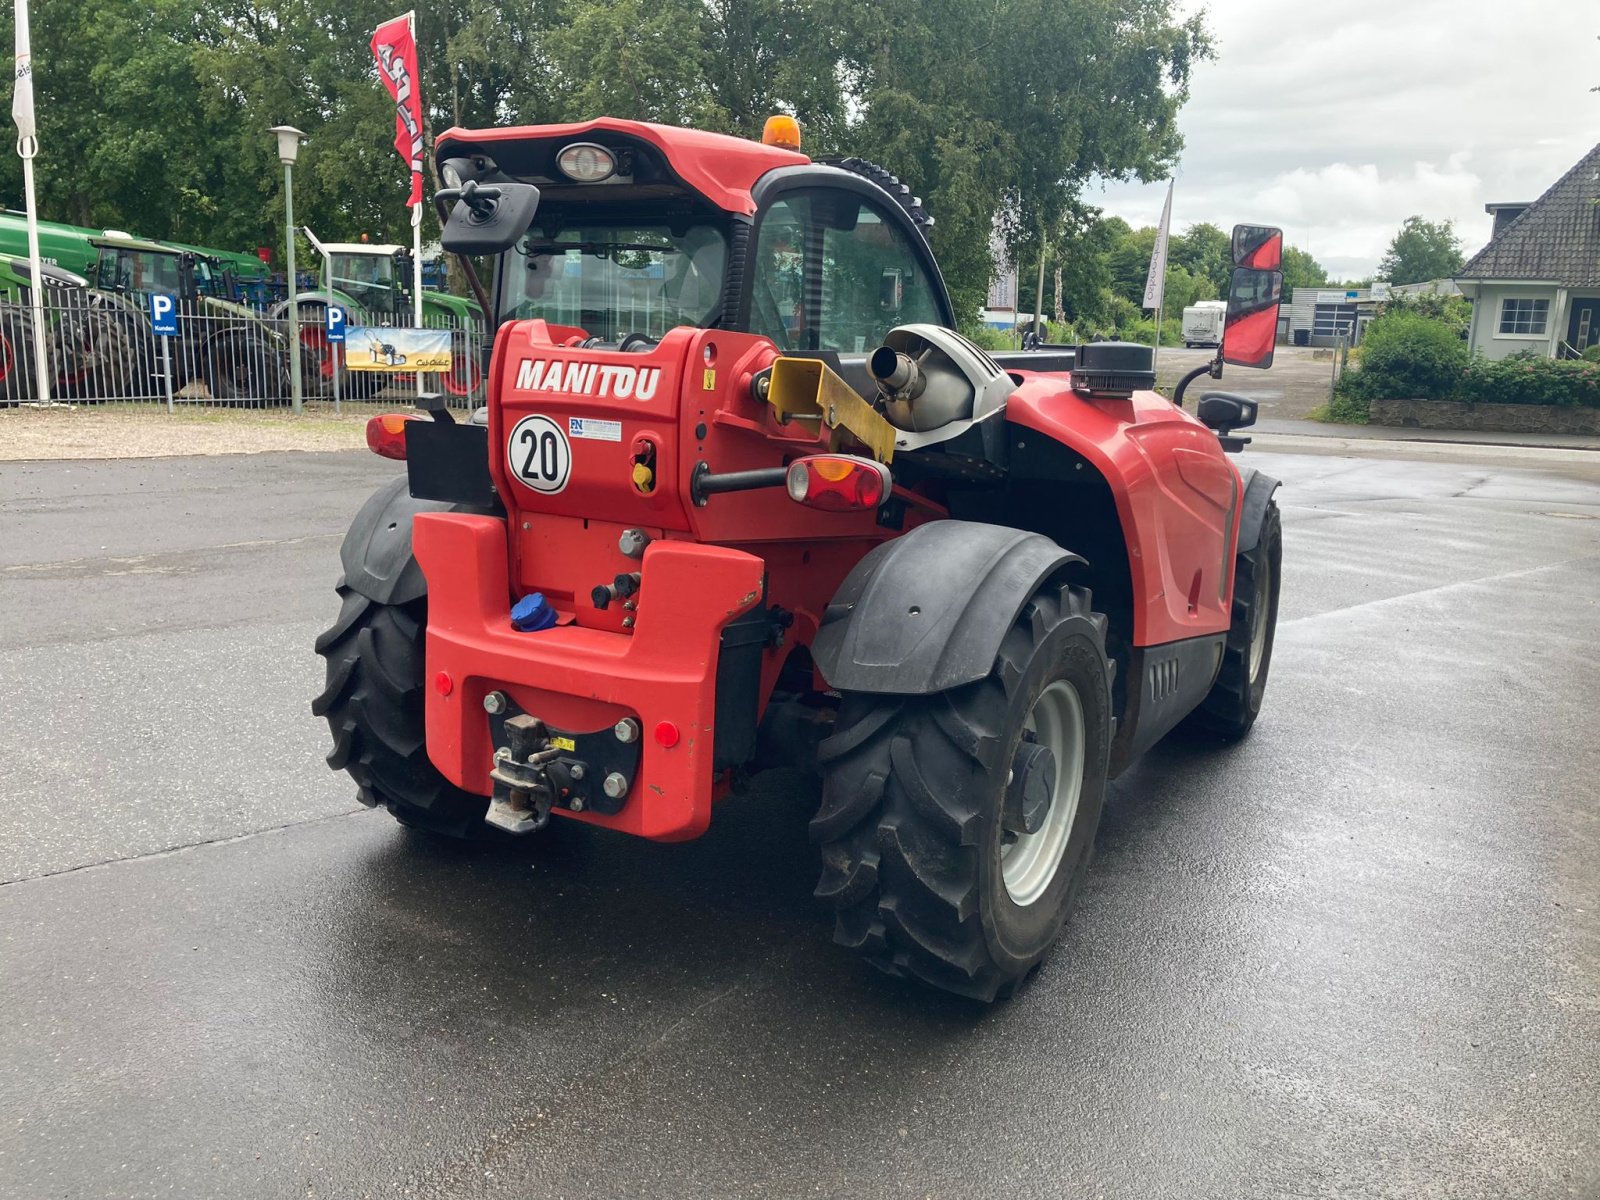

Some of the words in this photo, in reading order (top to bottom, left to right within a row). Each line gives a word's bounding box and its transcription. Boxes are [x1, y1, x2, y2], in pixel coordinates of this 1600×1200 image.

[153, 295, 171, 320] P
[328, 308, 342, 329] P
[515, 359, 661, 400] MANITOU
[520, 429, 558, 482] 20
